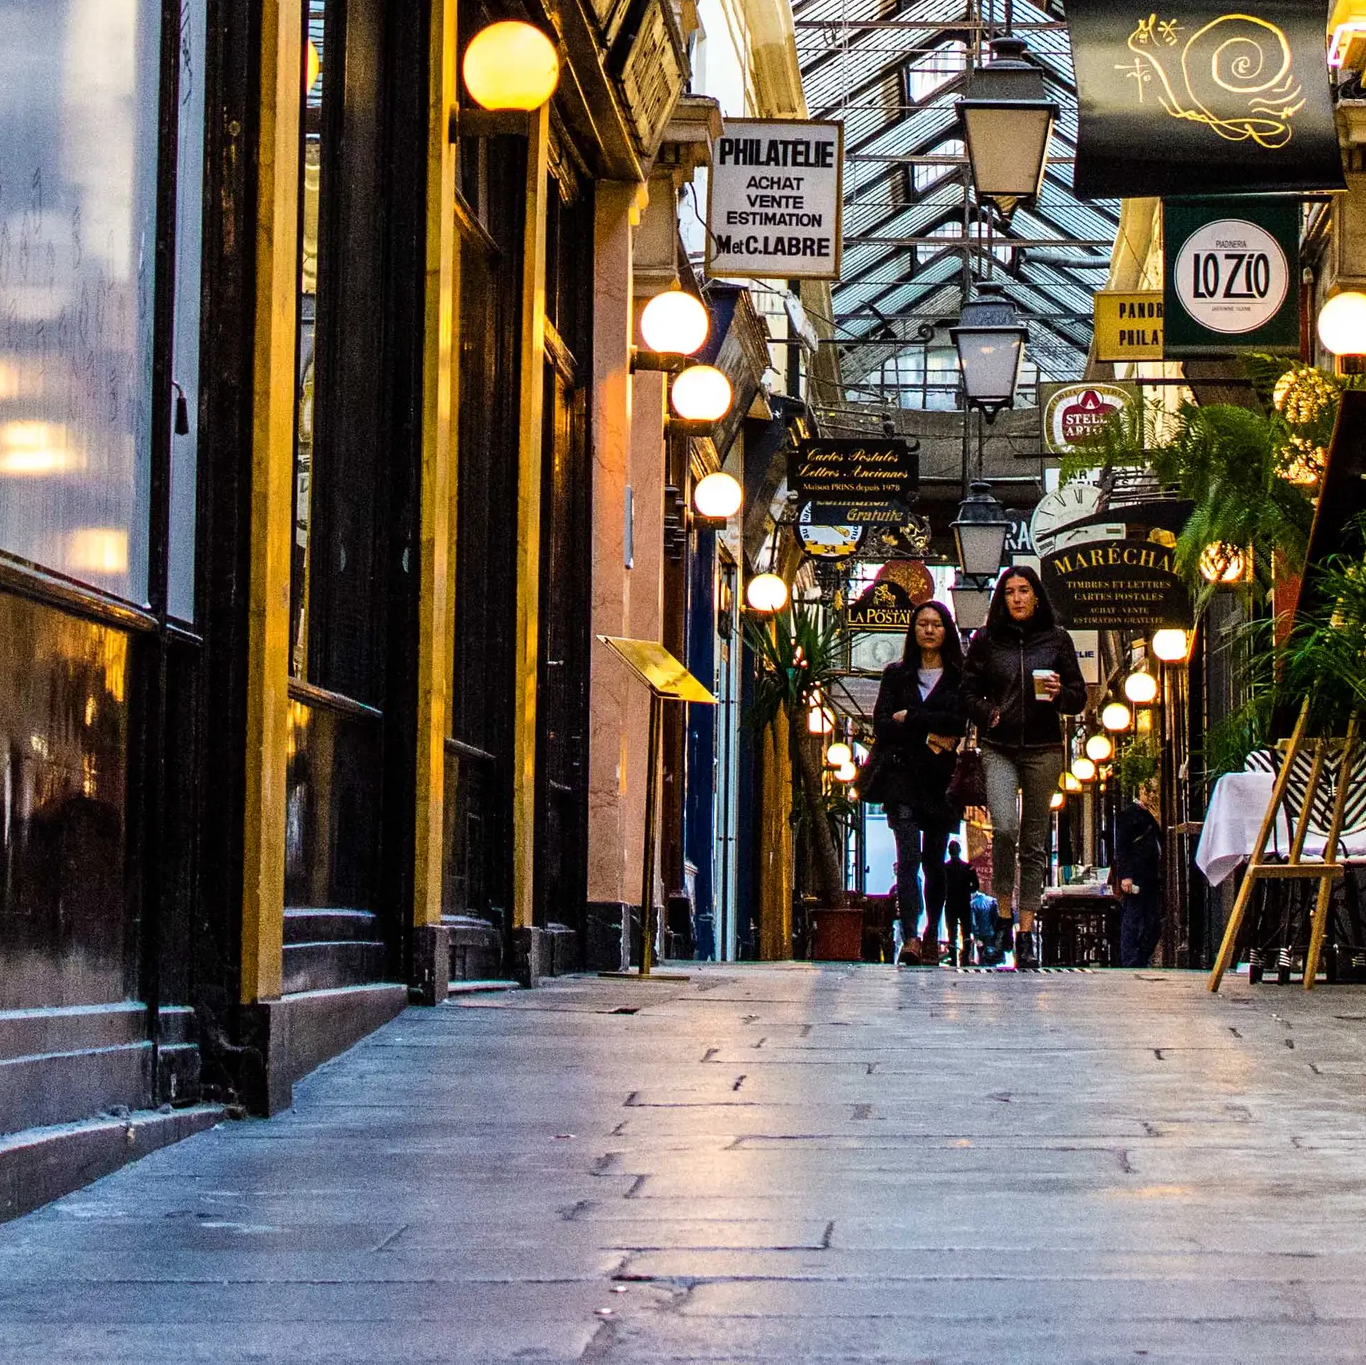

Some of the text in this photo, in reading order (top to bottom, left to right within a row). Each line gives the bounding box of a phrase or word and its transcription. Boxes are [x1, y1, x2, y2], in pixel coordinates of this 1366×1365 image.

[746, 175, 804, 190] ACHAT
[746, 194, 804, 209] VENTE
[726, 211, 823, 227] ESTIMATION
[1193, 252, 1220, 299] LO
[1119, 302, 1164, 318] PANOR
[1119, 329, 1164, 345] PHILA
[1065, 413, 1110, 425] STELL
[806, 447, 899, 463] Cartes Postales
[798, 463, 908, 479] Lettres Anciennes
[803, 483, 830, 491] Maison
[855, 483, 880, 492] depuis
[846, 507, 903, 522] Gratuite
[1066, 580, 1172, 589] TIMBRES ET LETTRES
[1074, 592, 1165, 601] CARTES POSTALES
[848, 608, 864, 623] LA
